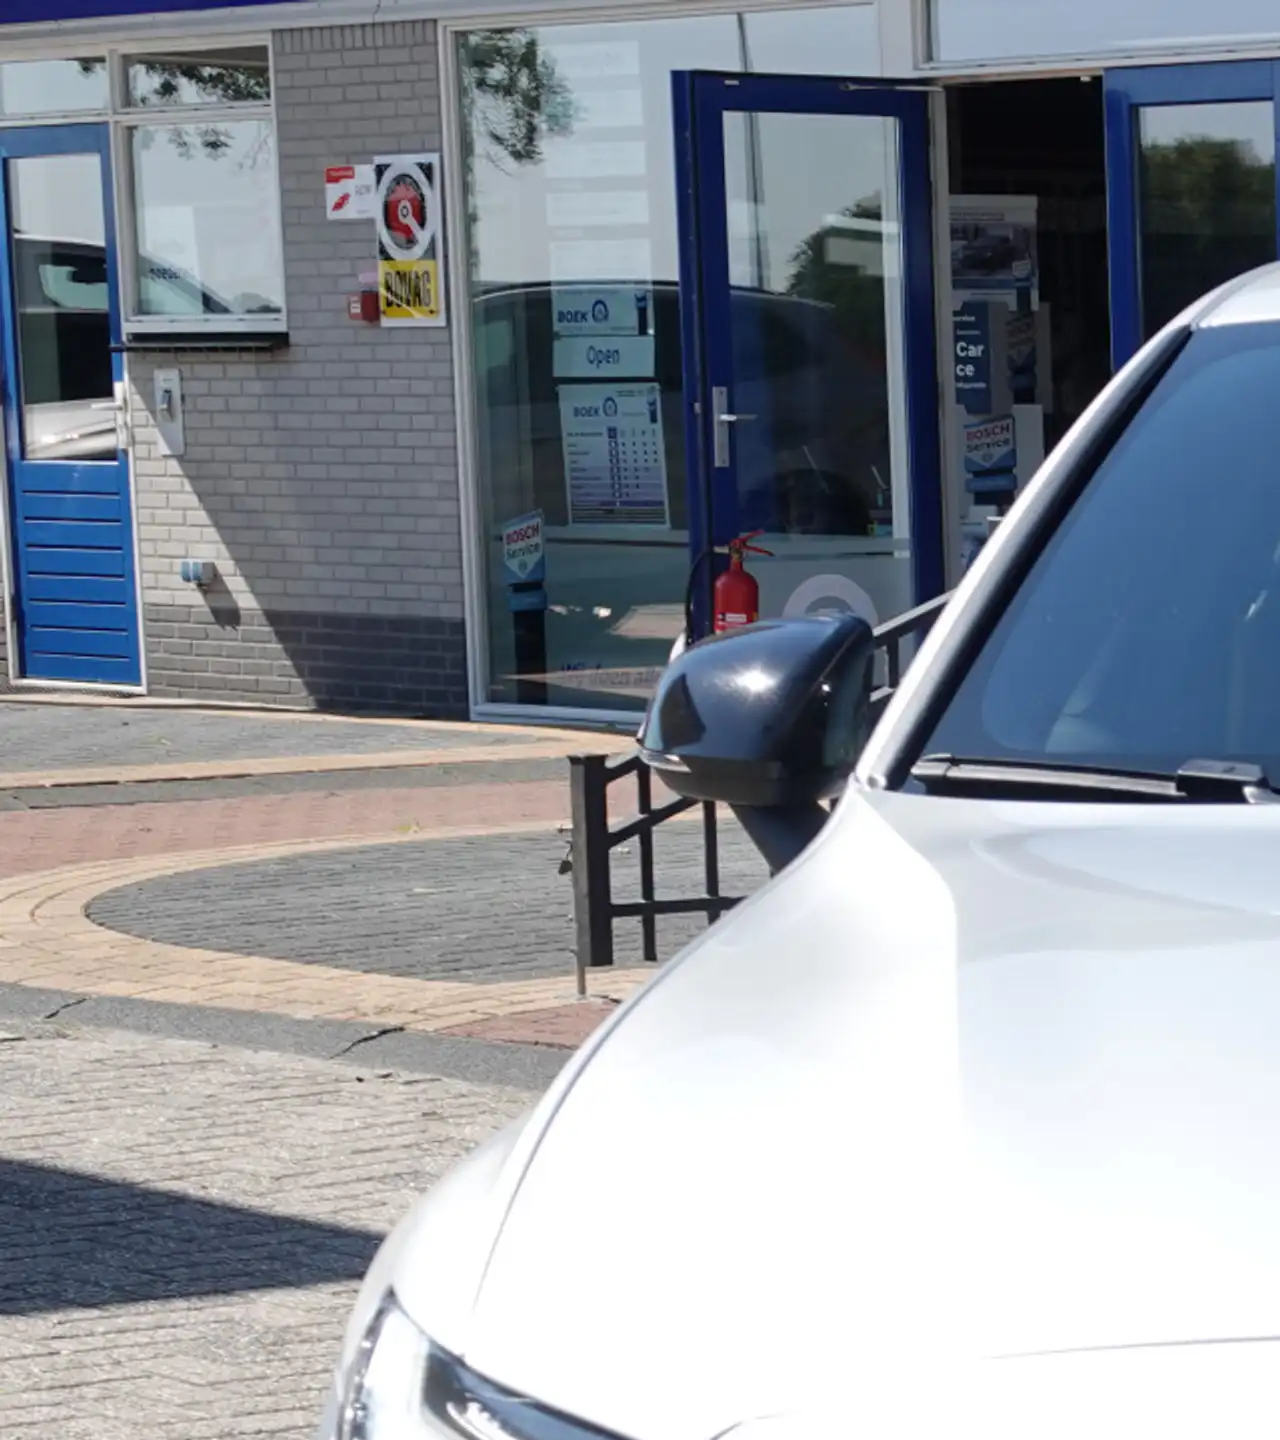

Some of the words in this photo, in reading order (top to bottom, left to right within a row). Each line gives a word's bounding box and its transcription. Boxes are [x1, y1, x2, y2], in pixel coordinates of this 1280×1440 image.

[384, 270, 432, 308] BOVAG
[586, 344, 620, 369] Open
[956, 341, 985, 357] Car
[573, 405, 600, 418] BOEK
[966, 423, 1010, 442] BOSCH
[966, 437, 1011, 453] Service
[506, 521, 540, 546] BOSCH
